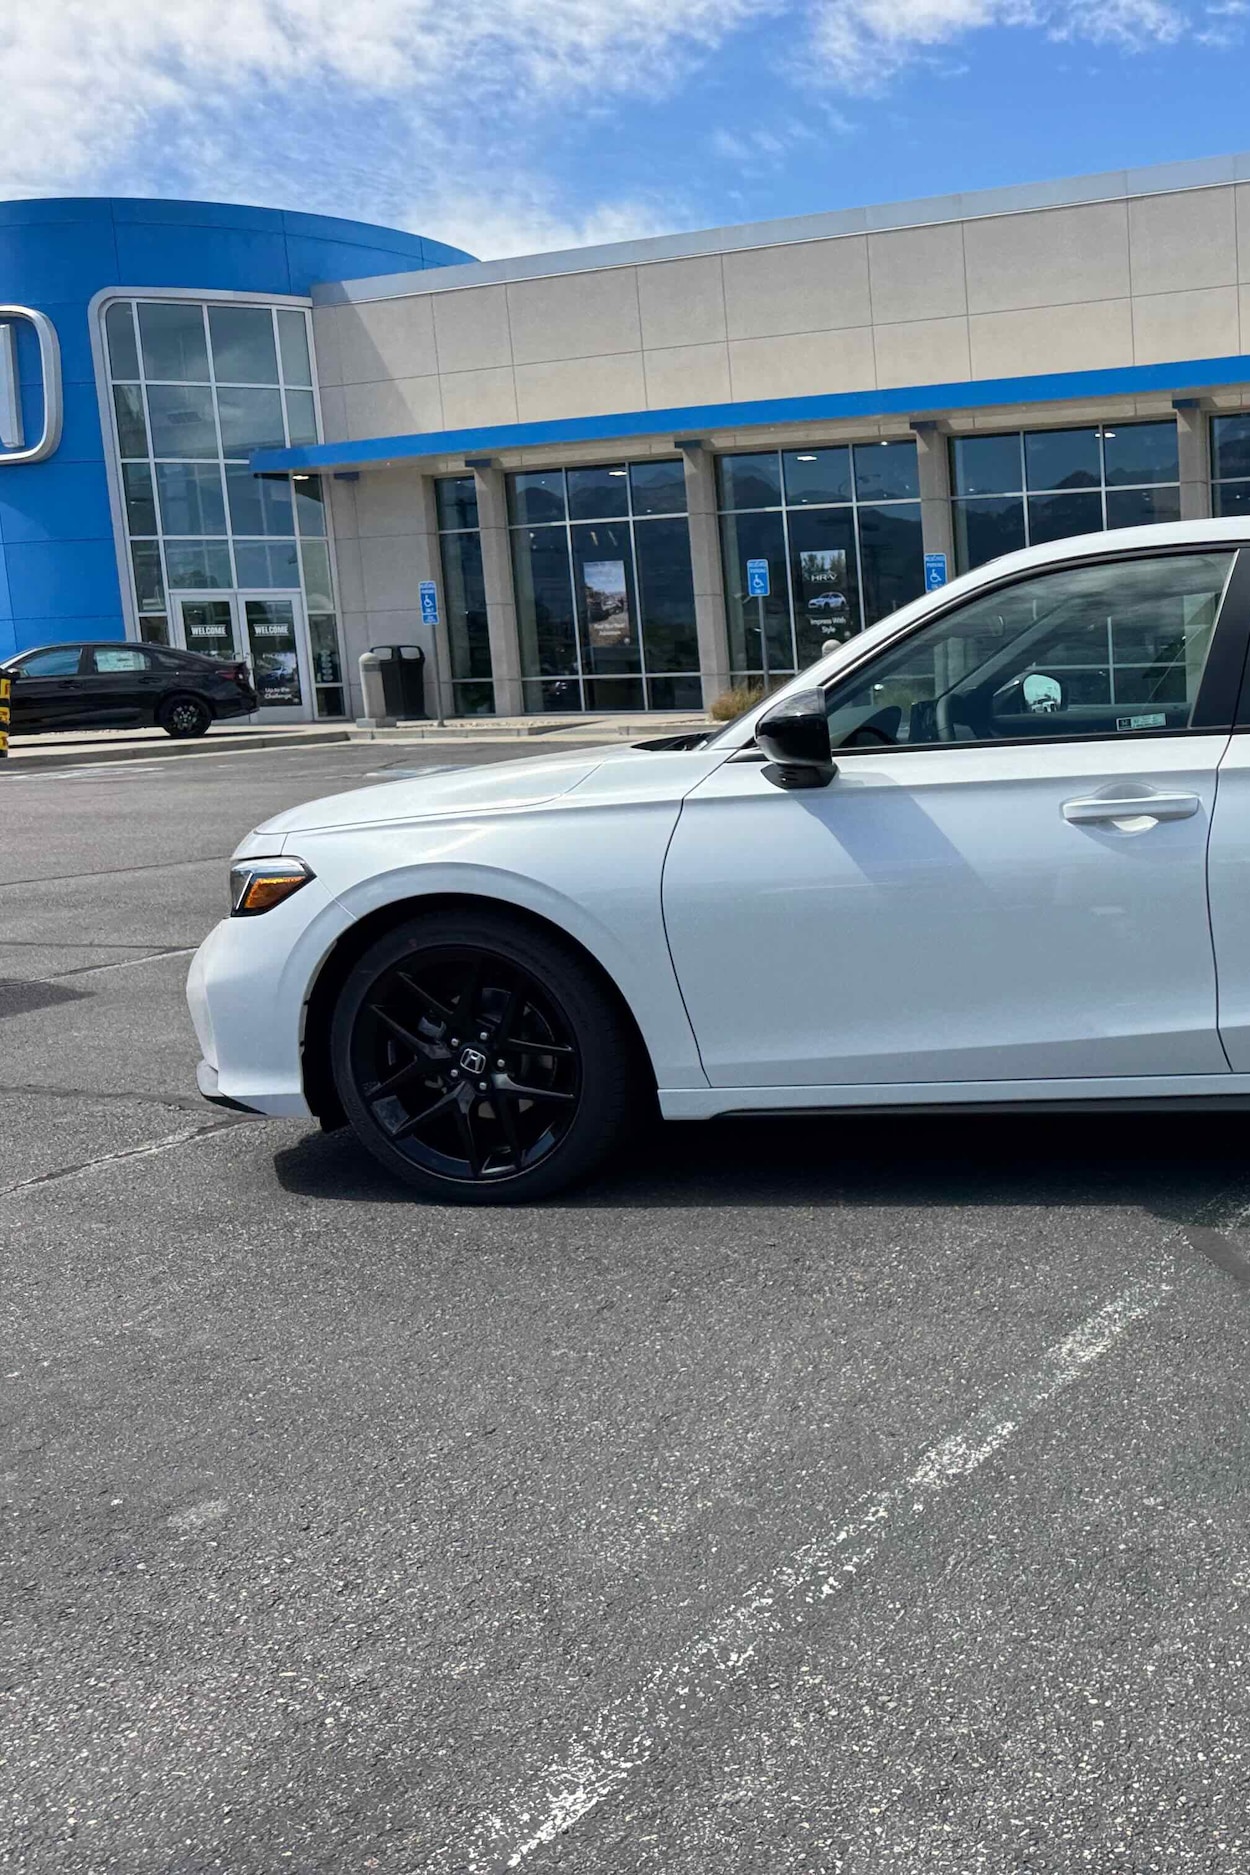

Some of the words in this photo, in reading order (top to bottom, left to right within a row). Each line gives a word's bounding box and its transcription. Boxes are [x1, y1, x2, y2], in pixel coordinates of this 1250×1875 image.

[811, 573, 838, 582] HR-V
[191, 627, 225, 635] WELCOME
[255, 626, 288, 634] WELCOME
